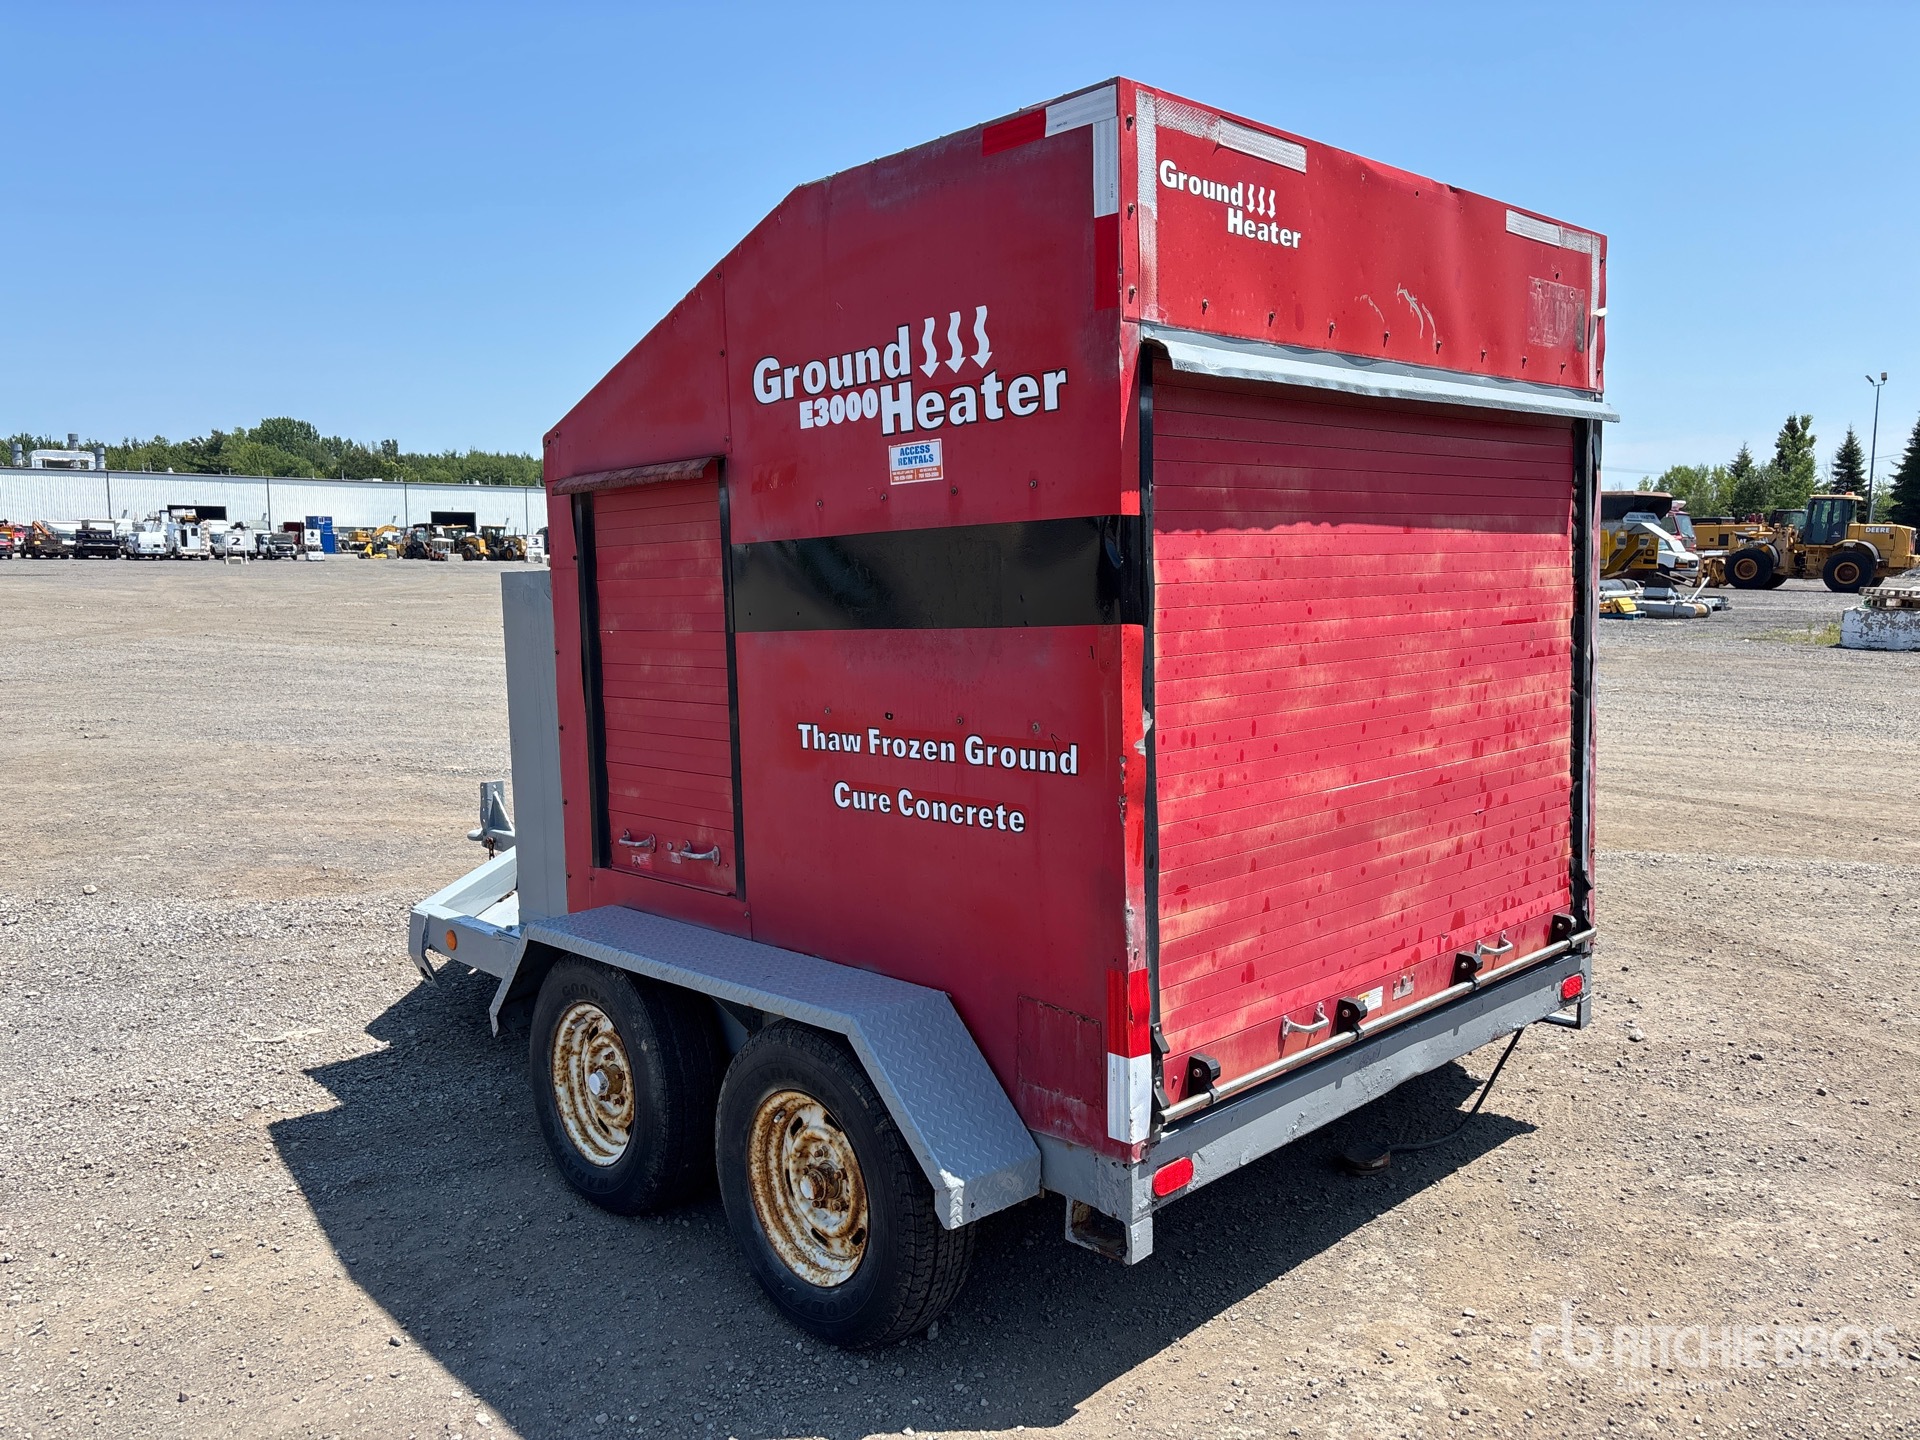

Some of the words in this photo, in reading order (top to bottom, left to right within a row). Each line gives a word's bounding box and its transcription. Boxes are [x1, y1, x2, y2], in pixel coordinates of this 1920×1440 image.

[1159, 159, 1244, 208] Ground
[1226, 206, 1302, 249] Heater
[752, 323, 911, 405] Ground
[799, 388, 879, 430] E3000
[881, 366, 1068, 437] Heater
[897, 454, 934, 466] RENTALS
[900, 444, 930, 456] ACCESS
[231, 537, 241, 546] 2
[1865, 526, 1891, 534] DEERE
[797, 723, 861, 753] Thaw
[867, 727, 956, 763] Frozen
[964, 734, 1079, 776] Ground
[833, 780, 892, 814] Cure
[897, 787, 1026, 833] Concrete
